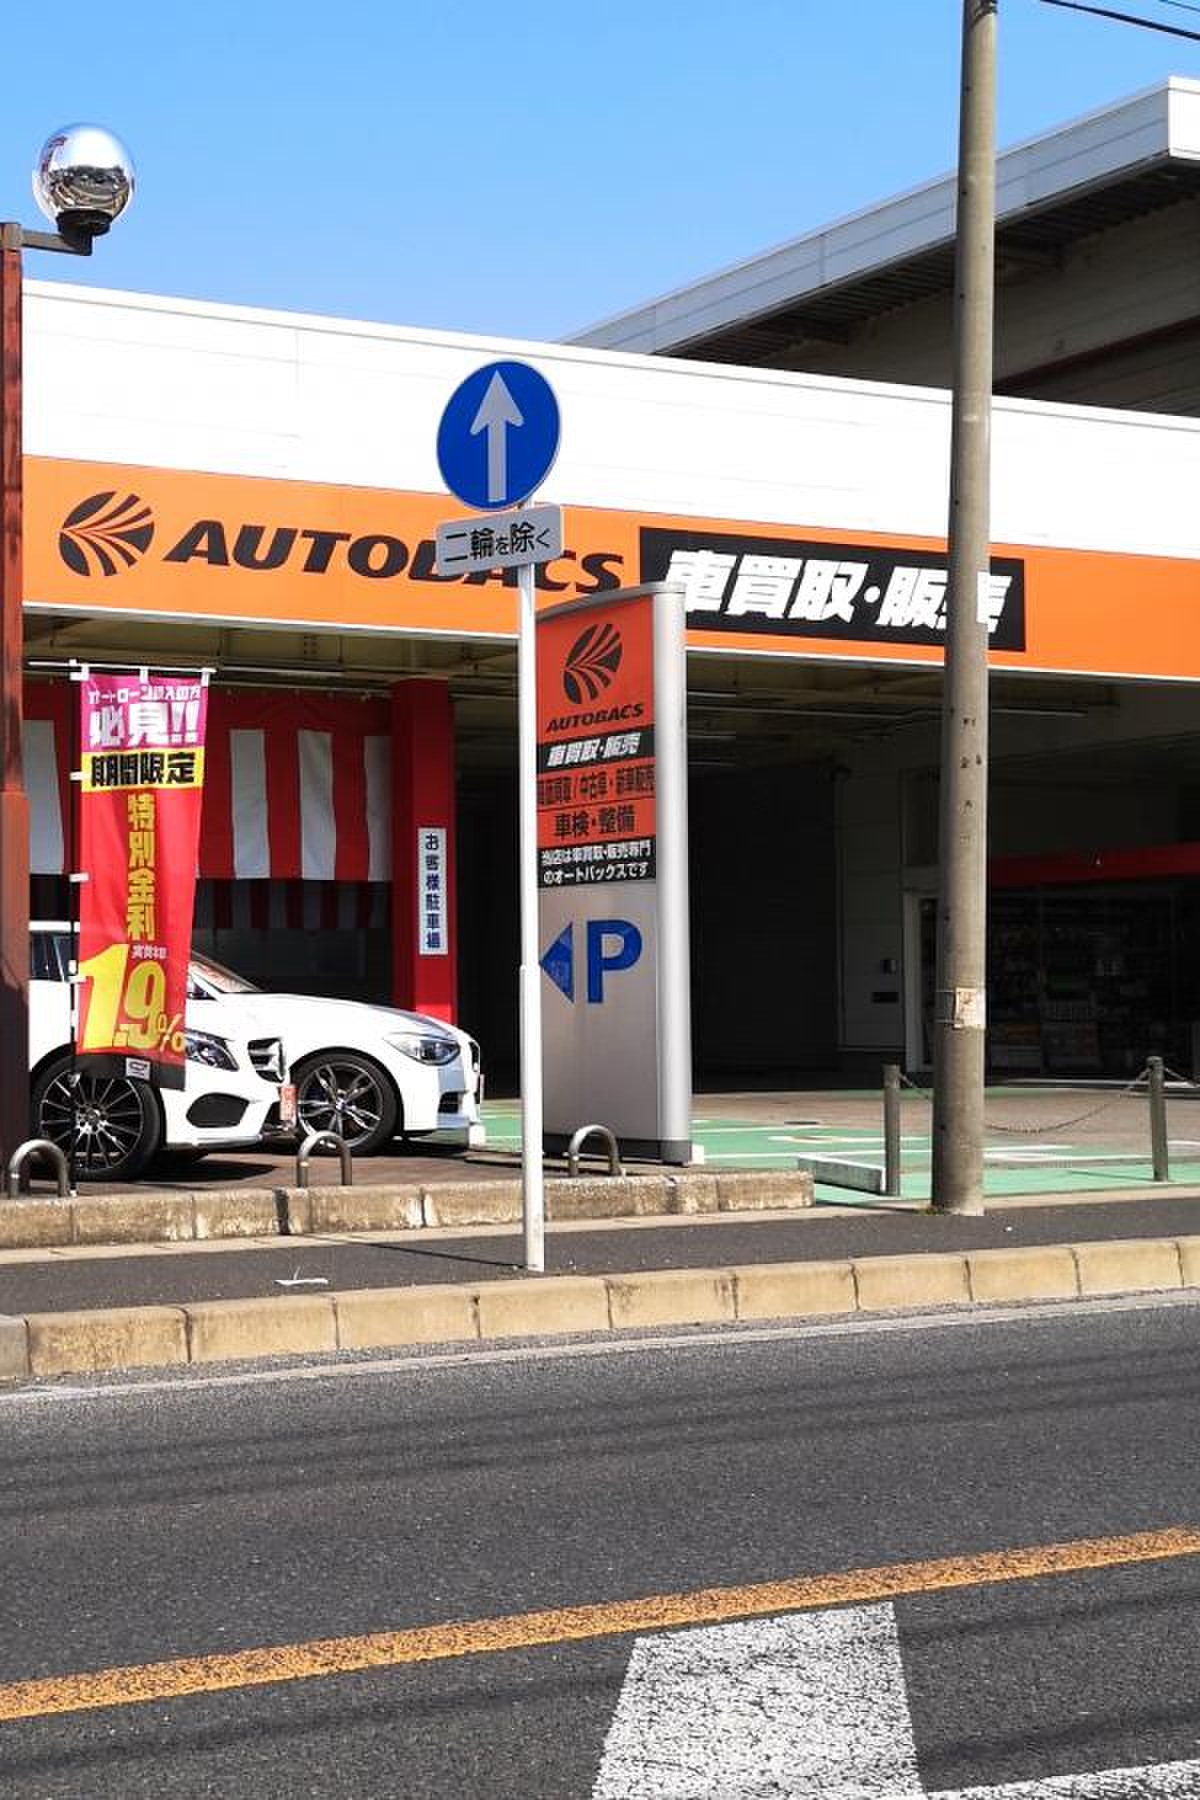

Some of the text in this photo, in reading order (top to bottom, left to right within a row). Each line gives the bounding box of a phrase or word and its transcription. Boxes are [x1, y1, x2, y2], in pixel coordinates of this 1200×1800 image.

[163, 519, 624, 593] AUTOCS
[444, 521, 551, 562] 二輪を除く
[546, 703, 644, 733] AUTOBACS
[91, 752, 196, 786] 期間限定
[555, 805, 635, 839] 車検・整備
[127, 793, 156, 942] 特別金利
[544, 862, 649, 885] のオートバックスです
[425, 833, 441, 948] お客様駐車場
[586, 919, 643, 1003] P
